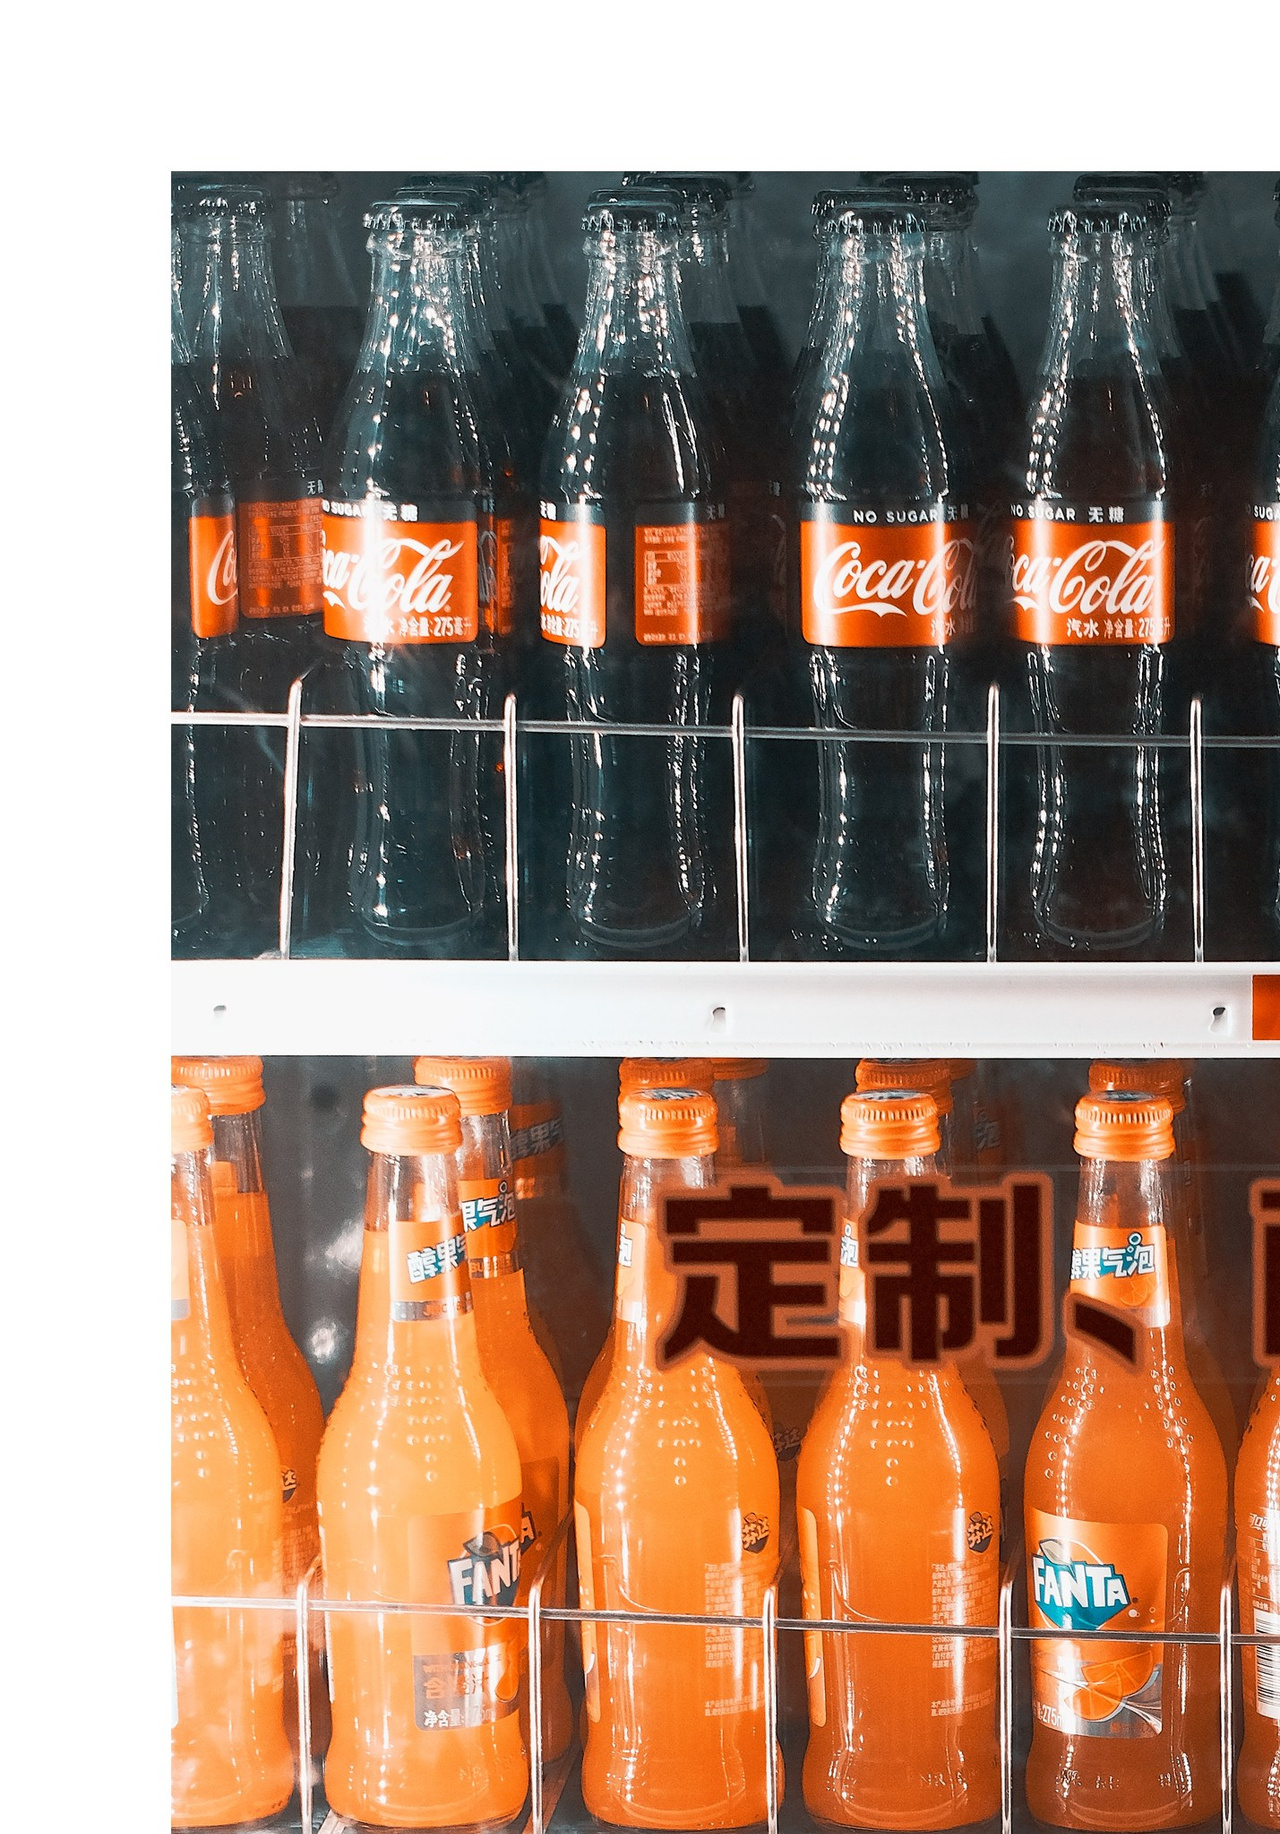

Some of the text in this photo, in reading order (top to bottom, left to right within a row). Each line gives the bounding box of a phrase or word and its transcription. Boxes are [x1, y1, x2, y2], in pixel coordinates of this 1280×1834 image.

[853, 509, 878, 524] NO
[886, 508, 939, 524] SUGAR
[1028, 505, 1077, 522] SUGAR
[1088, 507, 1125, 524] 无糖
[1033, 1555, 1129, 1608] FANTA
